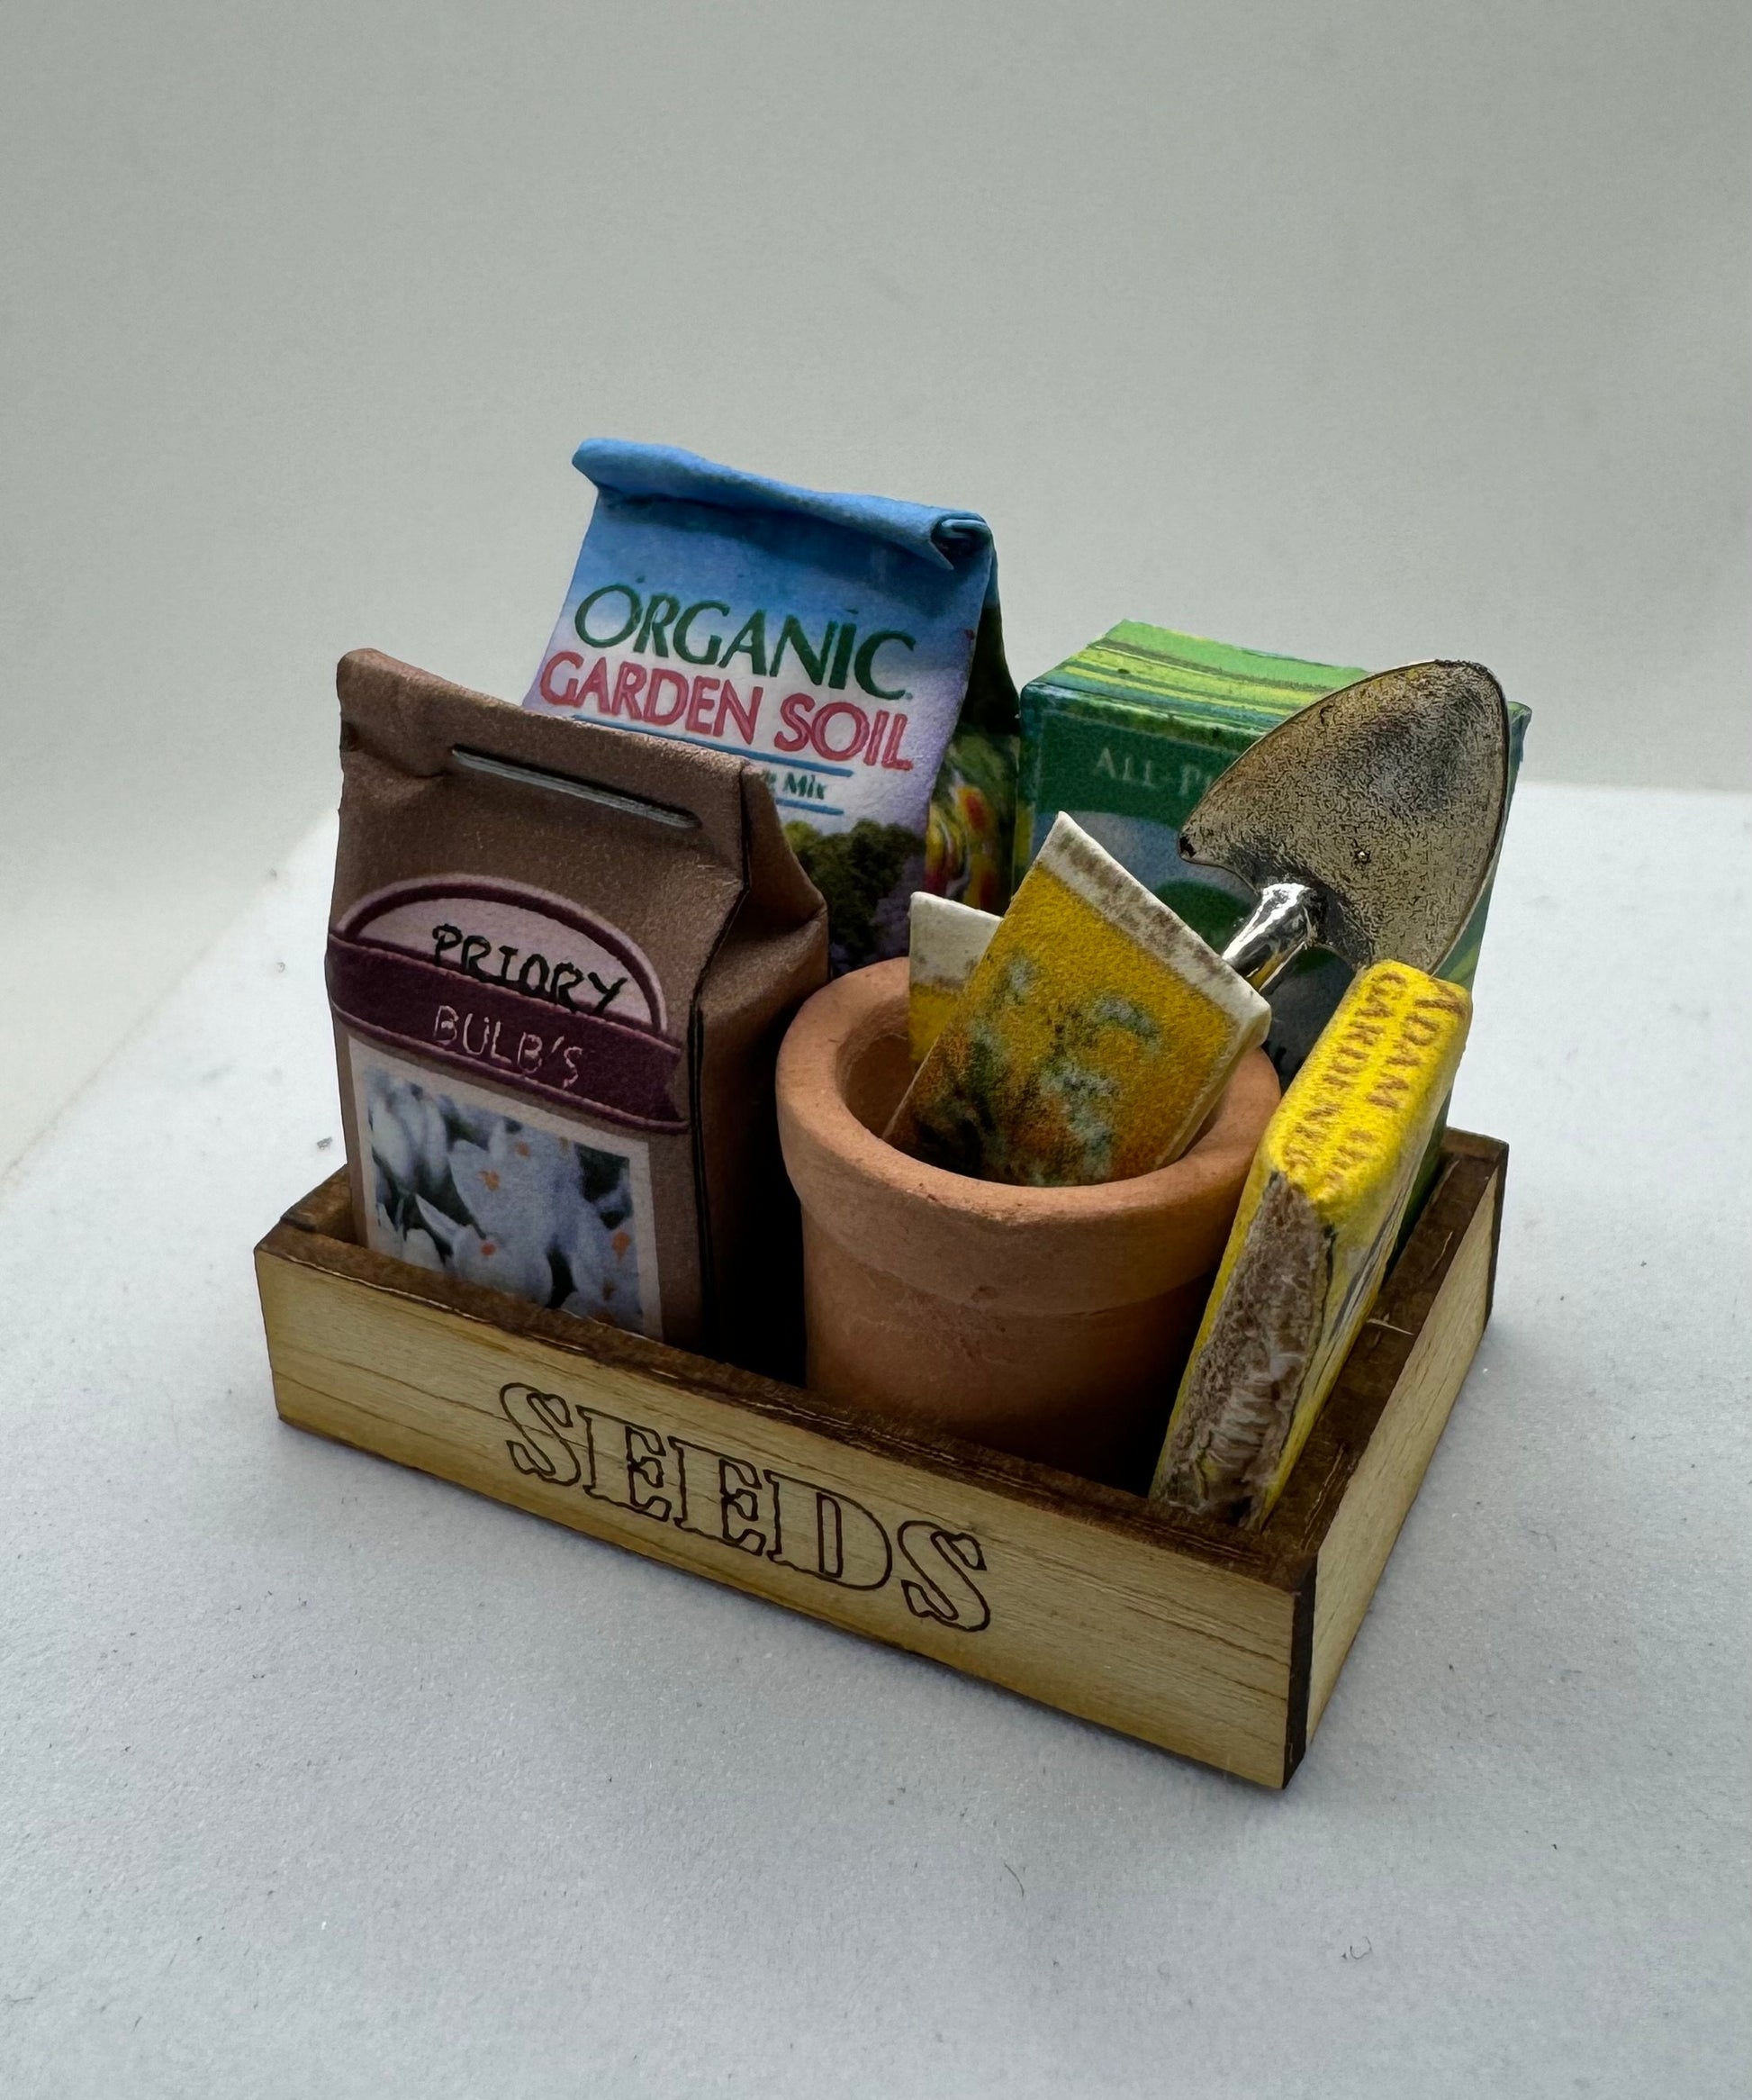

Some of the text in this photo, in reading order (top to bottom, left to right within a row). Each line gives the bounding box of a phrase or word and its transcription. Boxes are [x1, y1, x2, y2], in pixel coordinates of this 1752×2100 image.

[573, 583, 917, 701] ORGANIC
[539, 650, 914, 771] GARDEN SOIL
[431, 922, 628, 1014] PRIORY
[432, 1005, 583, 1089] BULB'S
[499, 1381, 991, 1632] SEEDS
